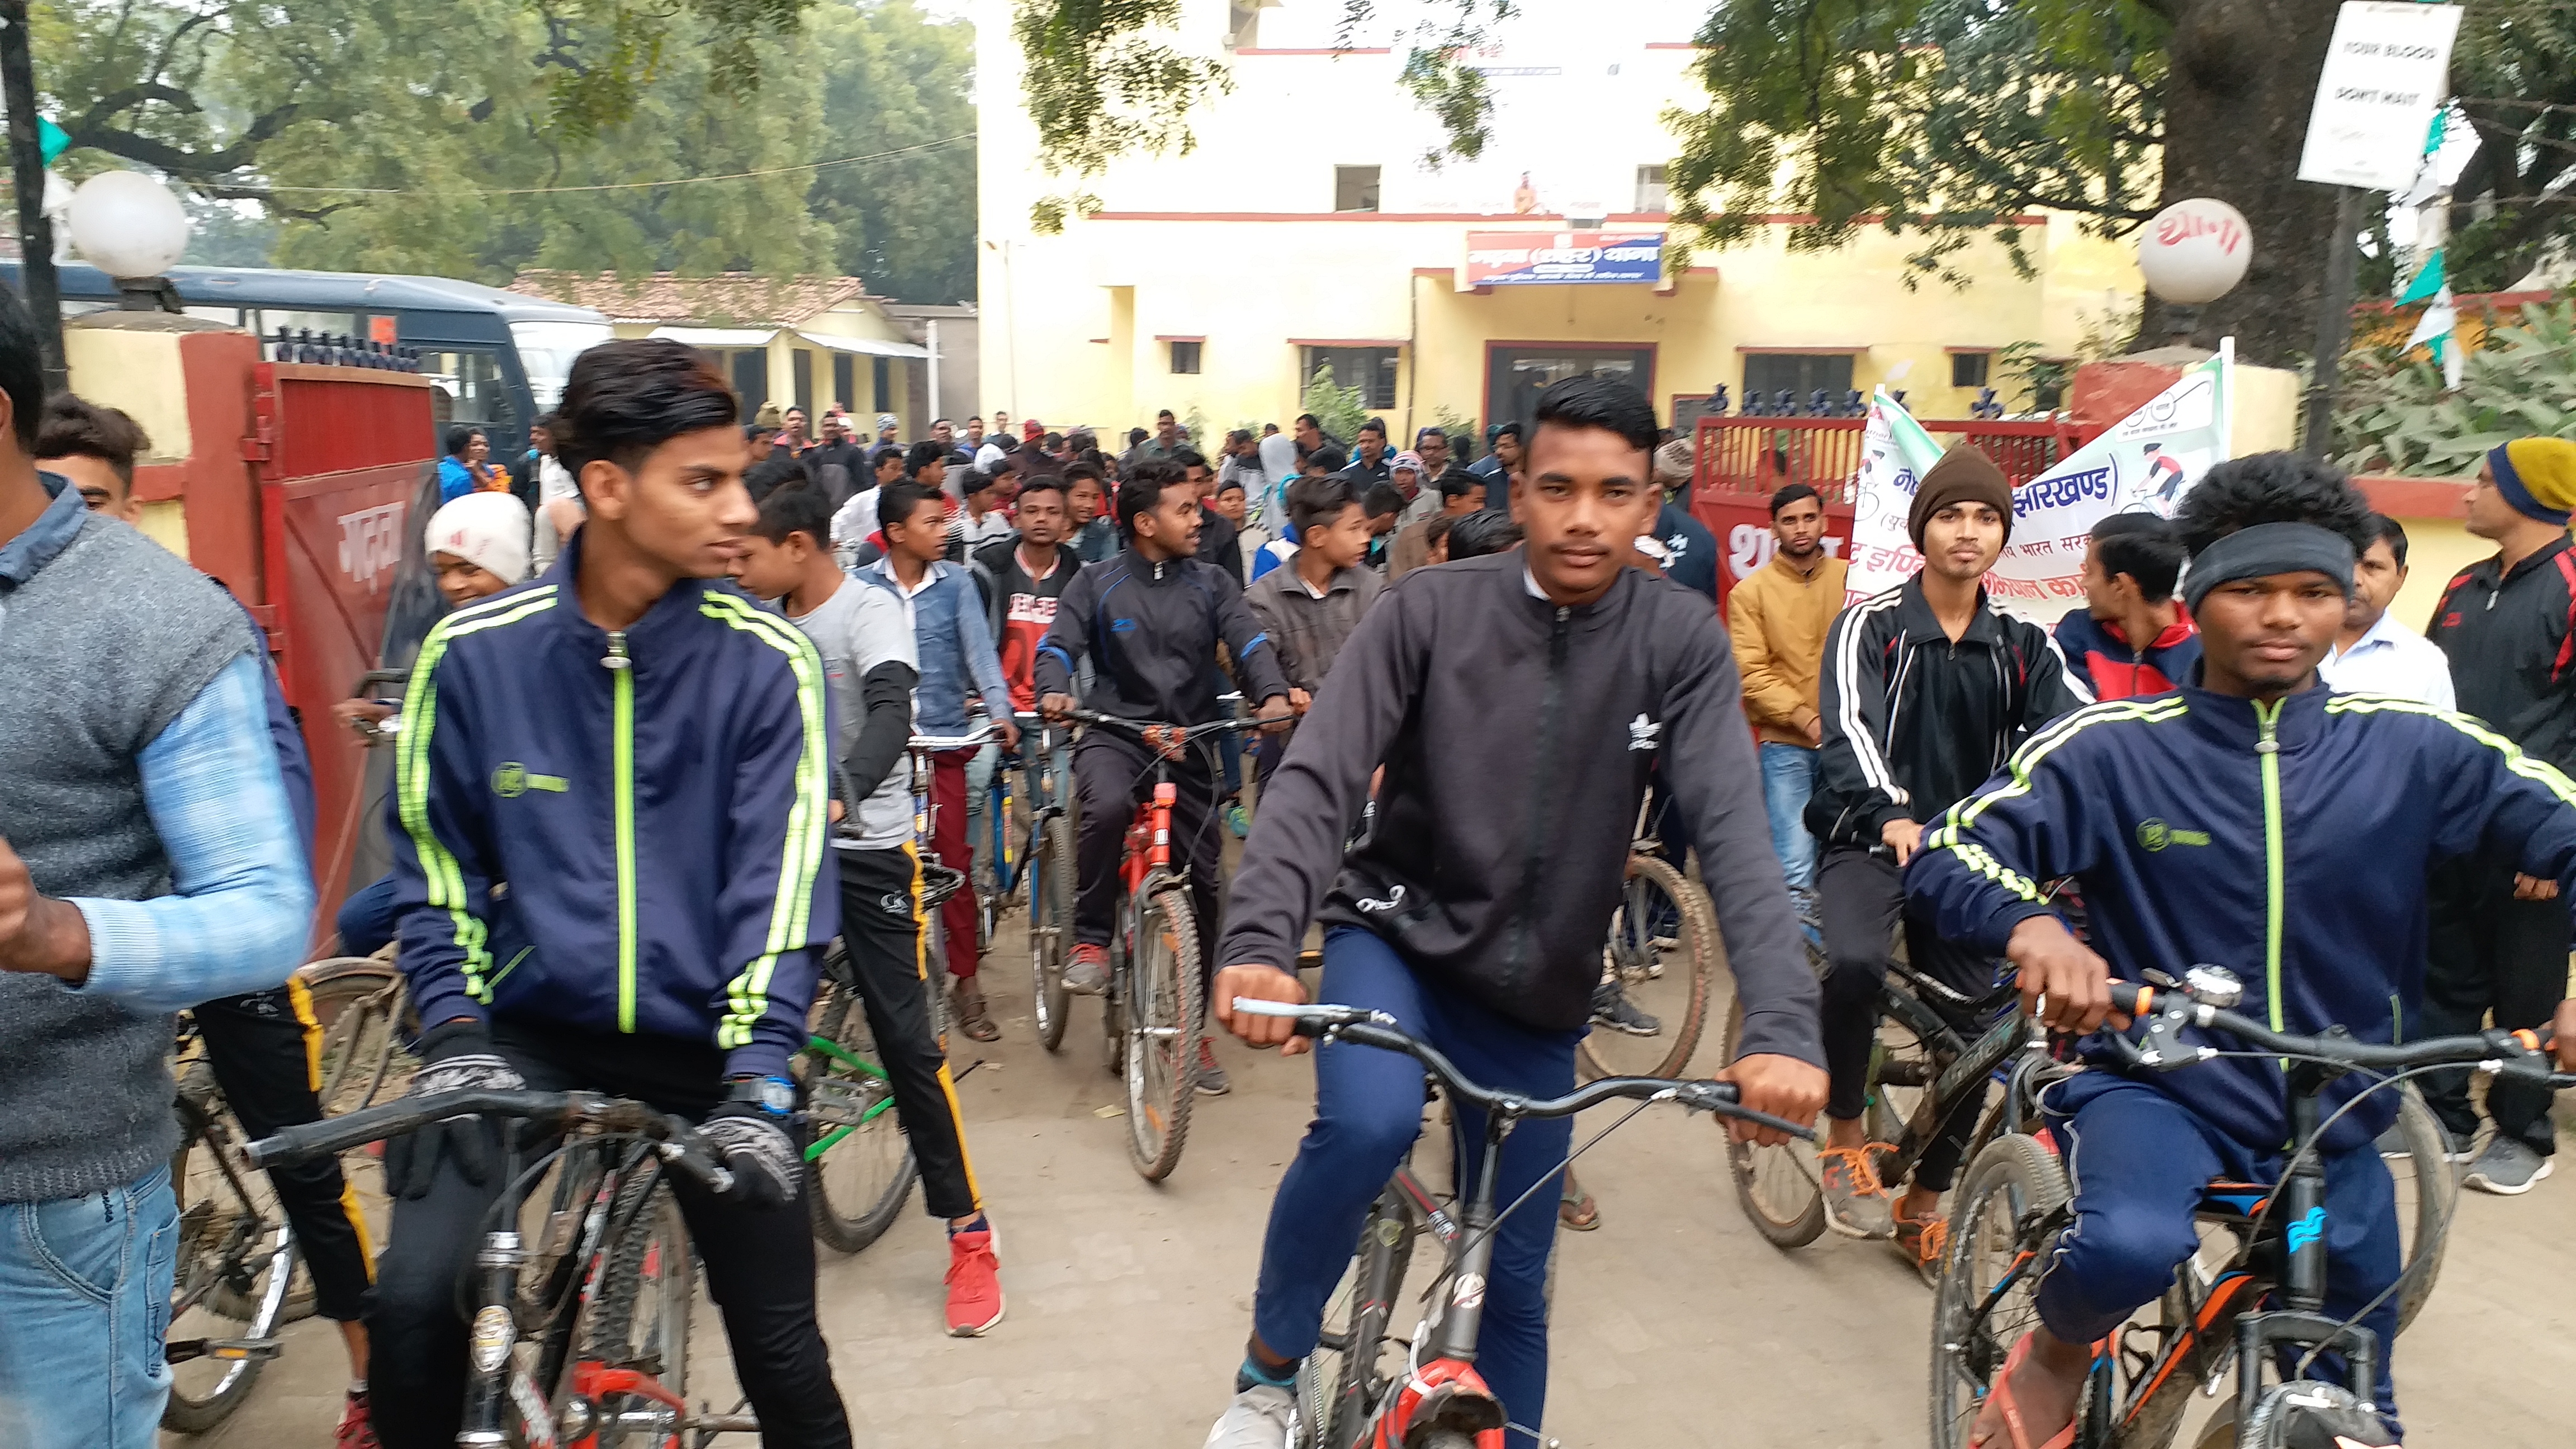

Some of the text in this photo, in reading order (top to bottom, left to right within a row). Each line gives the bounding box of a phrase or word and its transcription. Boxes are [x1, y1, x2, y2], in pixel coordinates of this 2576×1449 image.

[2383, 44, 2438, 60] BLOOD
[2380, 91, 2421, 106] WAIT
[2019, 540, 2053, 557] भारत
